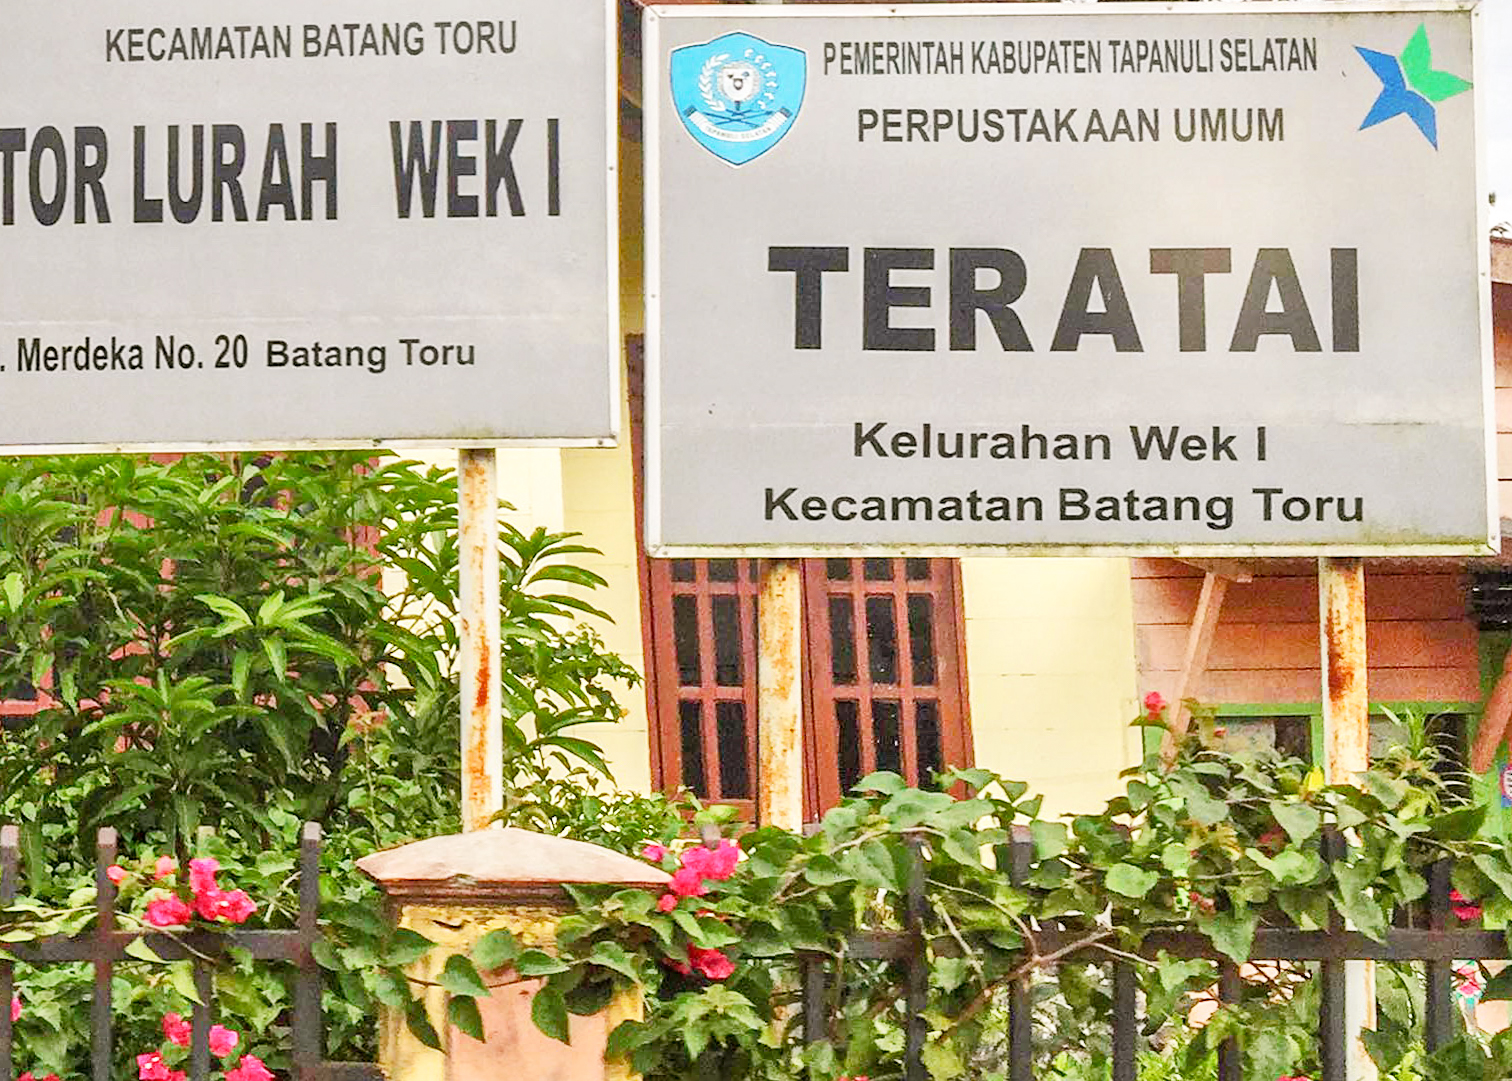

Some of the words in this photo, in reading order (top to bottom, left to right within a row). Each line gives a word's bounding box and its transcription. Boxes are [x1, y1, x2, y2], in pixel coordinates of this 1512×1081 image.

[106, 25, 291, 62] KECAMATAN
[303, 22, 424, 58] BATANG
[434, 20, 516, 55] TORU
[824, 41, 963, 75] PEMERINTAH
[971, 40, 1101, 75] KABUPATEN
[1108, 39, 1213, 73] TAPANULI
[1220, 37, 1317, 72] SELATAN
[858, 108, 1159, 143] PERPUSTAKAAN
[1174, 108, 1284, 142] UMUM
[133, 121, 338, 225] LURAH
[389, 118, 526, 219] WEK
[547, 118, 561, 217] I
[767, 246, 1360, 353] TERATAI
[17, 336, 144, 372] Merdeka
[155, 335, 203, 370] No.
[214, 334, 248, 369] 20
[266, 340, 386, 374] Batang
[398, 338, 475, 366] Toru
[854, 422, 1111, 460] Kelurahan
[1129, 425, 1238, 461] Wek
[1257, 426, 1266, 461] I
[765, 487, 1043, 522] Kecamatan
[1059, 488, 1234, 531] Batang
[1252, 488, 1363, 522] Toru
